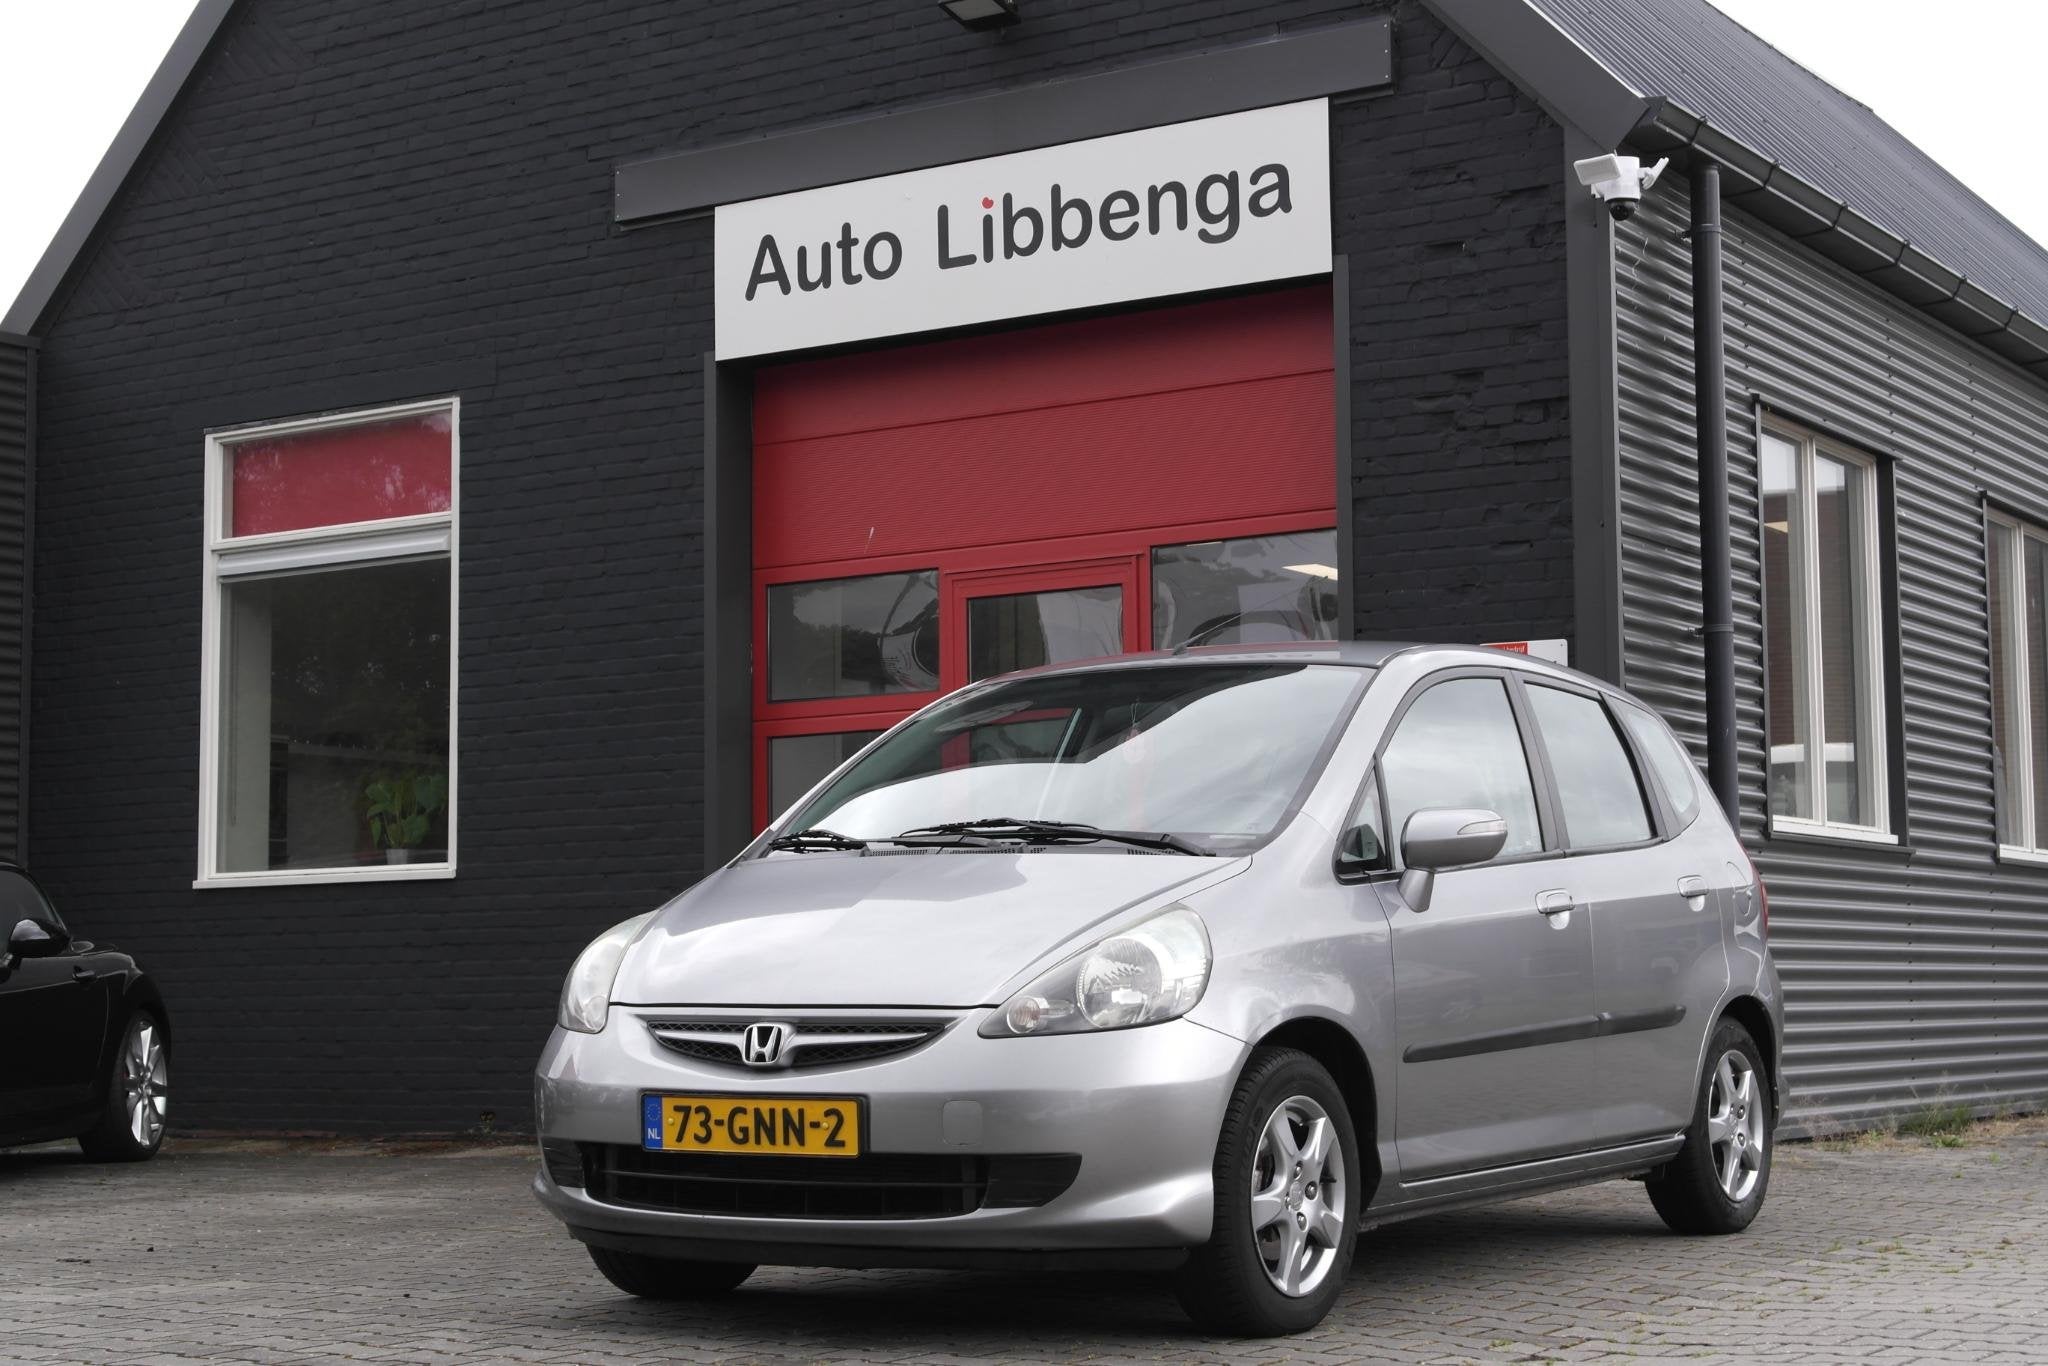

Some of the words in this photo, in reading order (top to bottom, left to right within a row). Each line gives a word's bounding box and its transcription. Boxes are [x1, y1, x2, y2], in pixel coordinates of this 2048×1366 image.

[745, 222, 902, 301] Auto
[937, 163, 1292, 270] Libbenga
[648, 1127, 661, 1140] NL
[673, 1105, 846, 1148] 73-GNN-2
